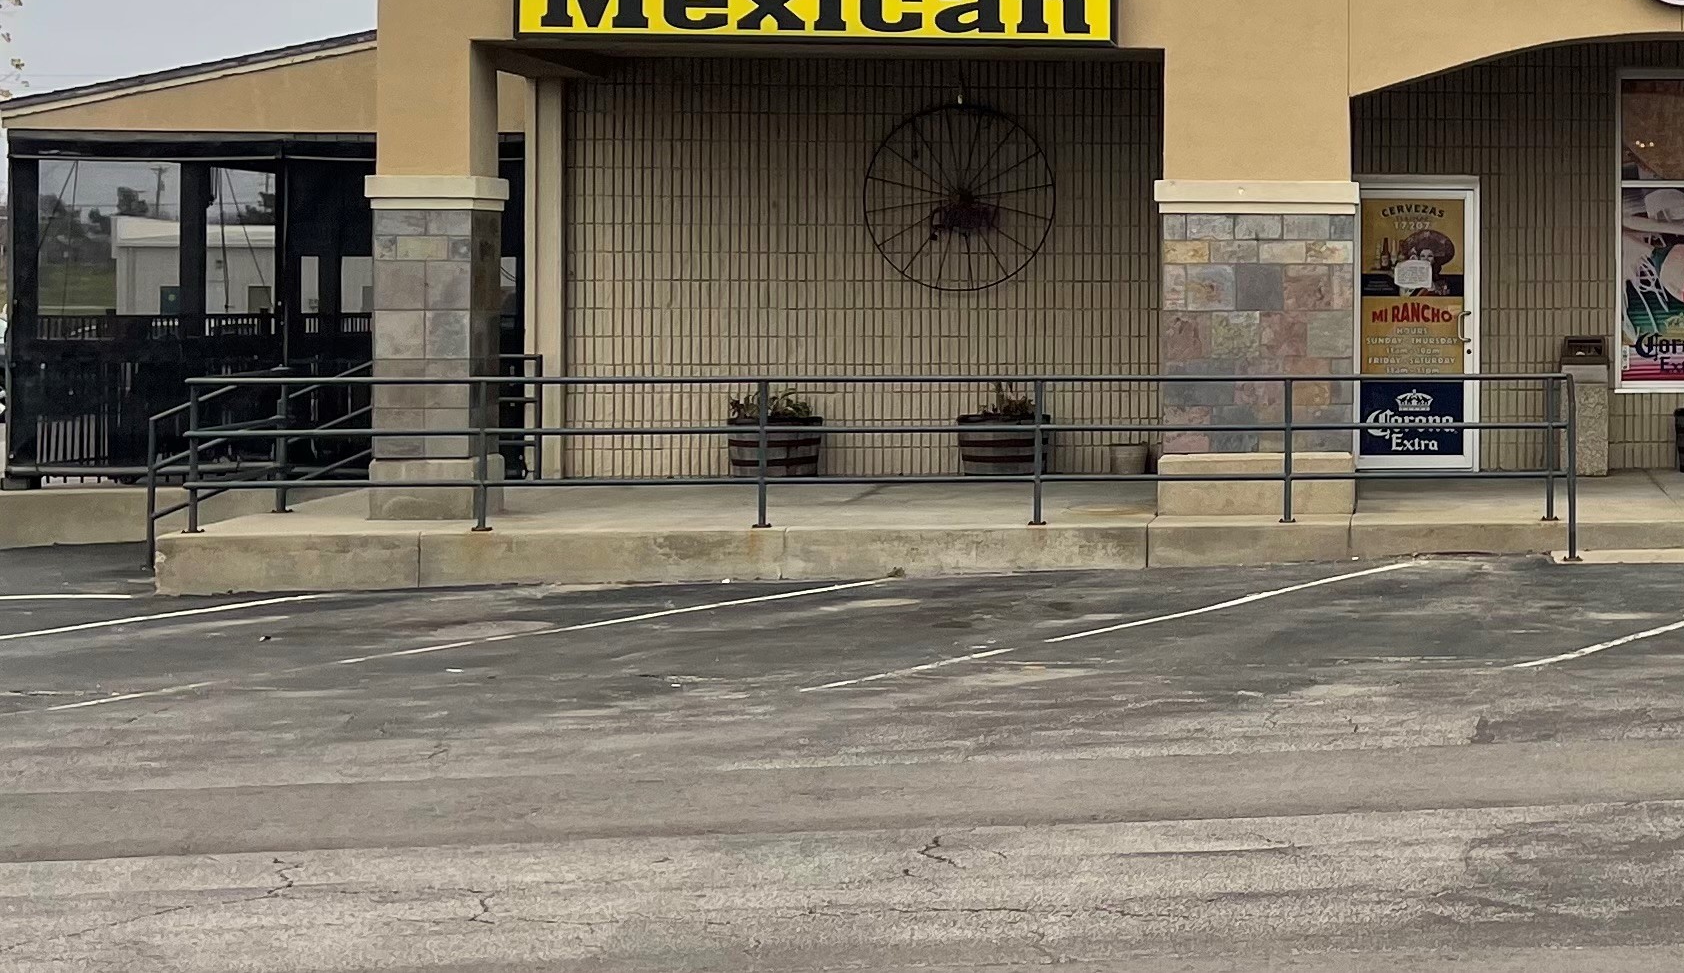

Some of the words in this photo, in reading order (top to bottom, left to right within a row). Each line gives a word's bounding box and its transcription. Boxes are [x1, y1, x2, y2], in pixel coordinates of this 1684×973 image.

[1381, 204, 1445, 218] CERVEZAS
[1371, 309, 1388, 323] MI
[1391, 302, 1453, 323] RANCHO
[1365, 409, 1456, 439] Corona
[1391, 433, 1439, 451] Extra
